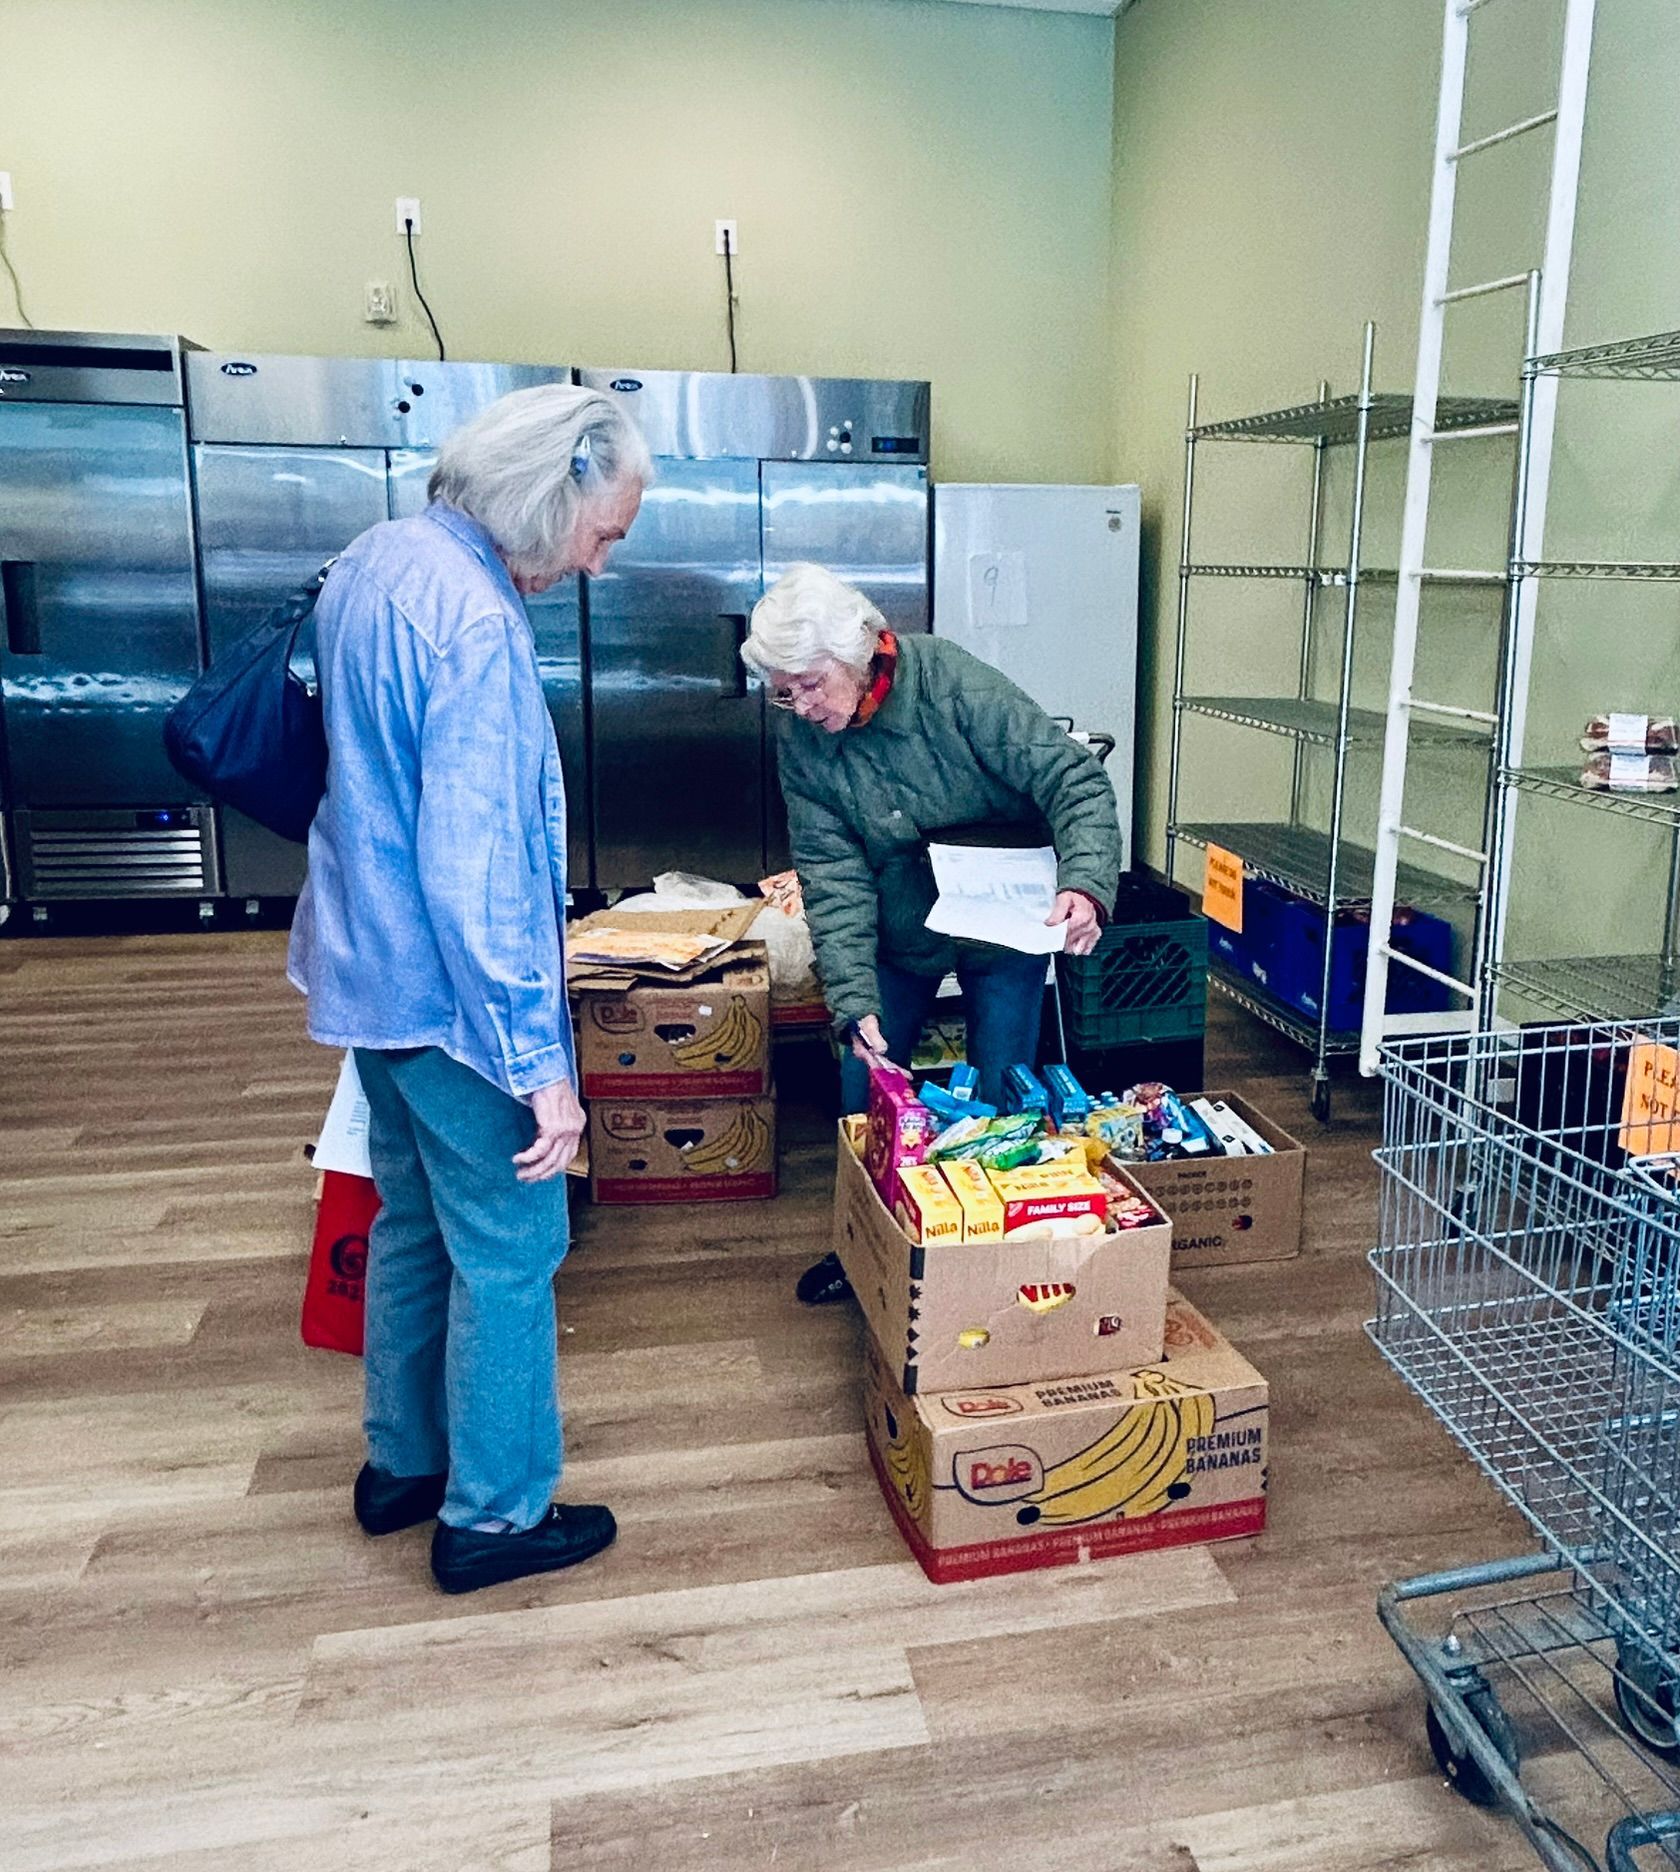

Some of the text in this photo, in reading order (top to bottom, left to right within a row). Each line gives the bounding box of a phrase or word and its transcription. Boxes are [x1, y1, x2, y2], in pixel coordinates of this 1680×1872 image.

[984, 565, 999, 607] 9
[1640, 1093, 1669, 1118] NOT
[1027, 1200, 1092, 1216] FAMILY SIZE
[925, 1222, 958, 1238] Nilla
[967, 1221, 1000, 1237] Nilla
[1172, 1235, 1222, 1250] RGANIC
[1035, 1379, 1115, 1400] PREMIUM
[1041, 1389, 1122, 1408] BANANAS
[1186, 1427, 1262, 1453] PREMIUM
[1186, 1447, 1261, 1474] BANANAS
[971, 1457, 1032, 1489] Dole
